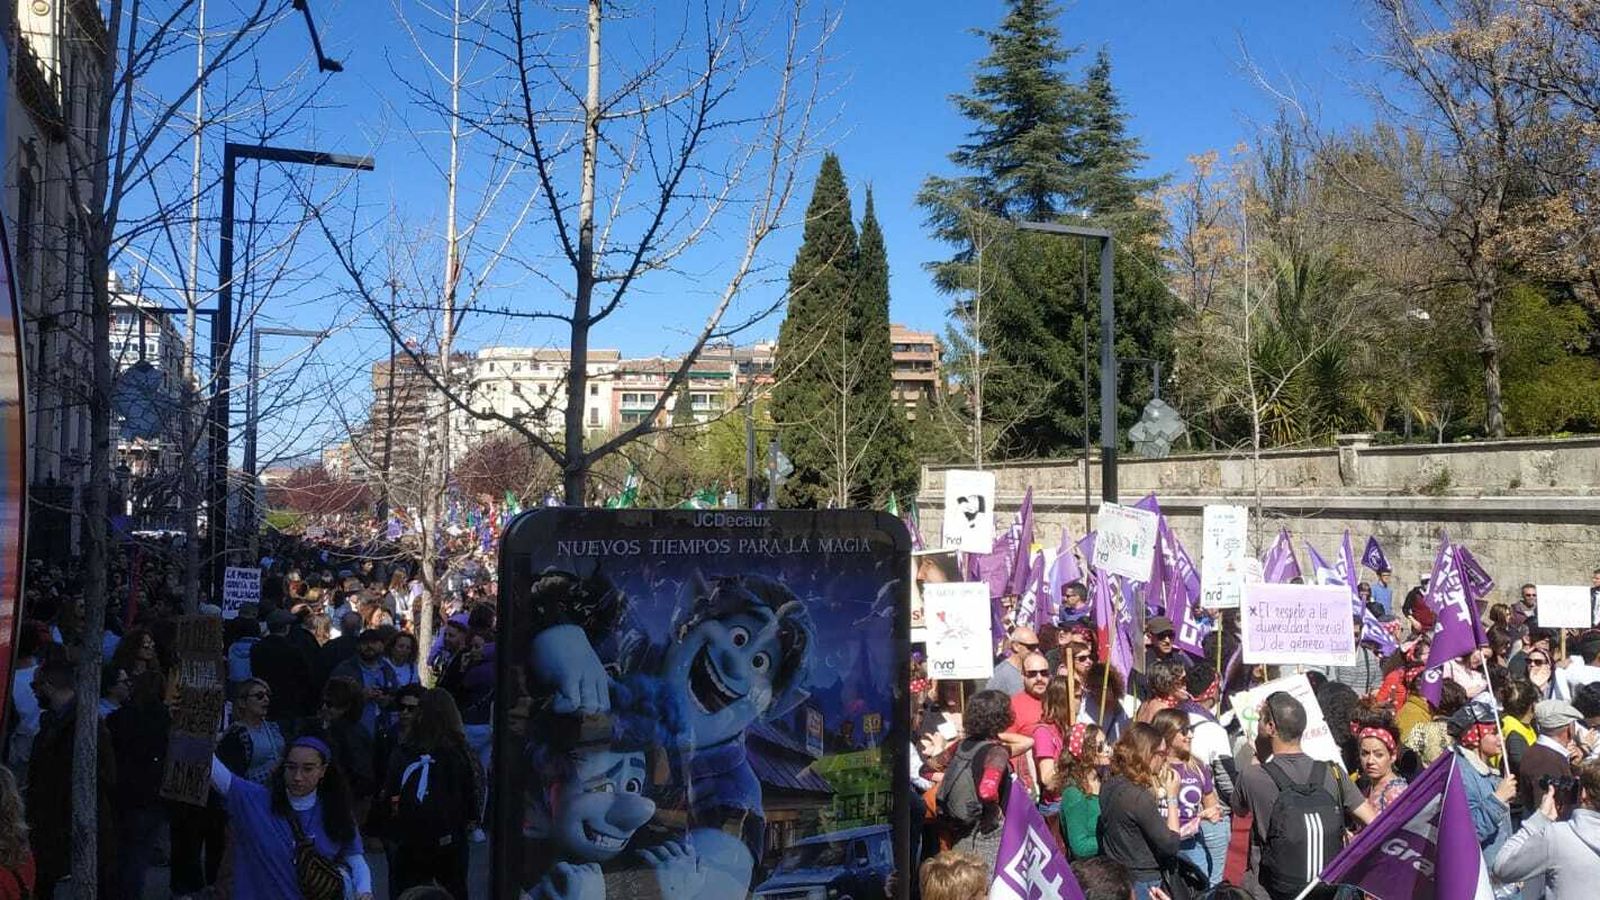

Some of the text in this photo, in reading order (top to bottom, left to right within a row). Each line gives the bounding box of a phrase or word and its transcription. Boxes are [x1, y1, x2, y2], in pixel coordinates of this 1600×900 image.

[693, 512, 772, 527] JCDecaux
[557, 538, 872, 558] NUEVOS TIEMPOS PARA LA MAGIA
[1259, 601, 1269, 618] El
[1309, 608, 1316, 618] a
[1319, 602, 1328, 618] la
[1315, 620, 1345, 635] sexual
[1269, 635, 1284, 650] de
